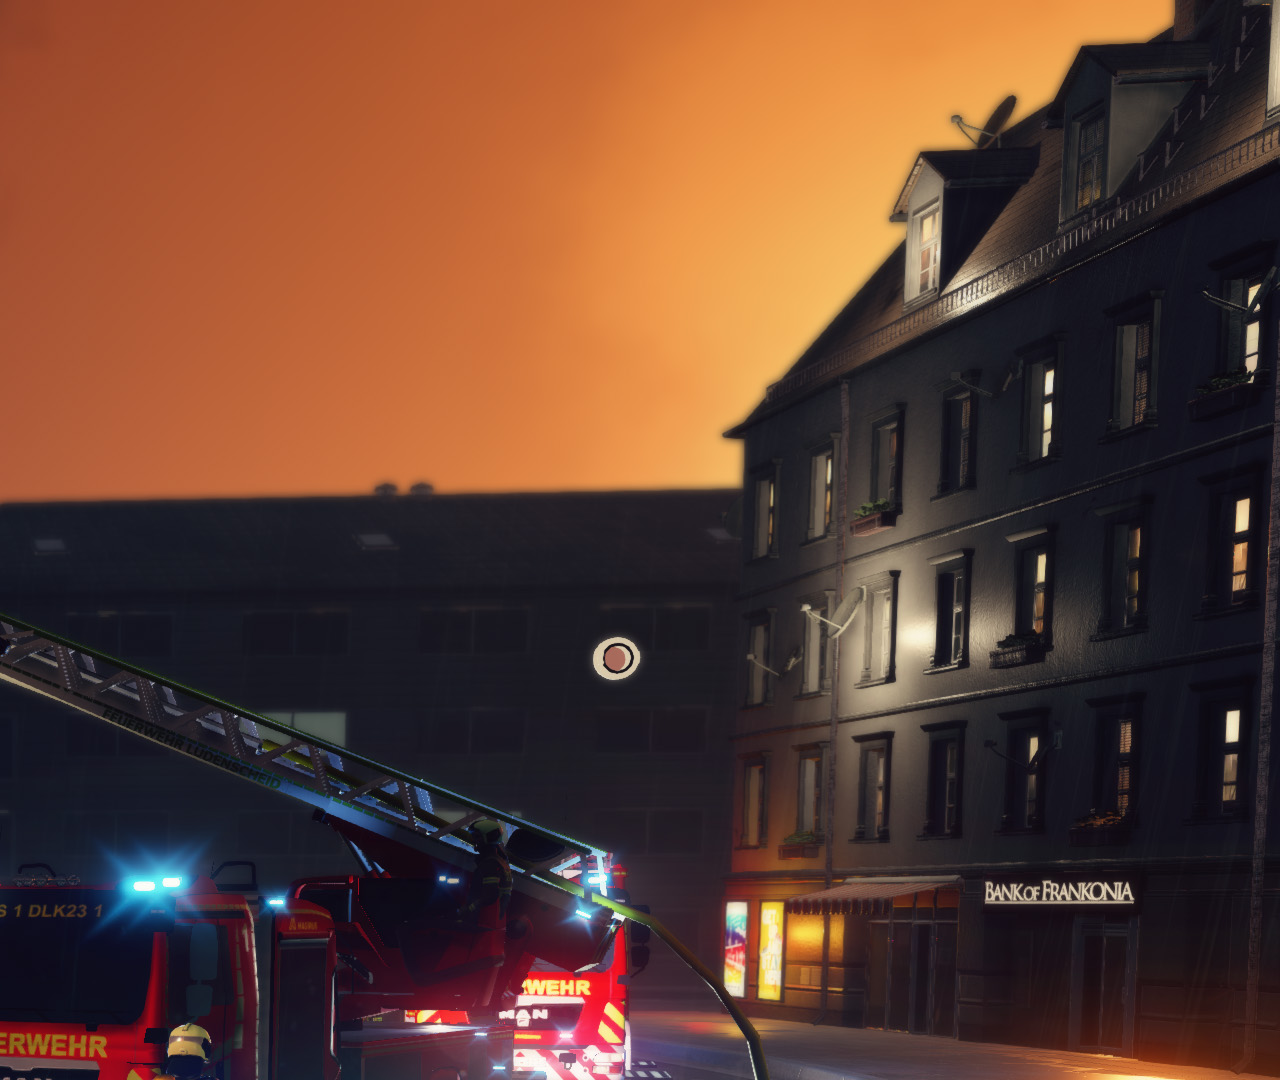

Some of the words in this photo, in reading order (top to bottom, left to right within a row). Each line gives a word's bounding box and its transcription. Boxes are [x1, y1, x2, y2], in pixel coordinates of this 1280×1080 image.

[985, 881, 1024, 901] BANK
[1023, 886, 1040, 901] OF
[1042, 880, 1135, 901] FRANKONIA
[14, 904, 22, 918] 1
[28, 904, 87, 918] DLK23
[94, 904, 103, 918] 1
[522, 979, 591, 996] WEHR
[499, 1009, 548, 1020] MAN
